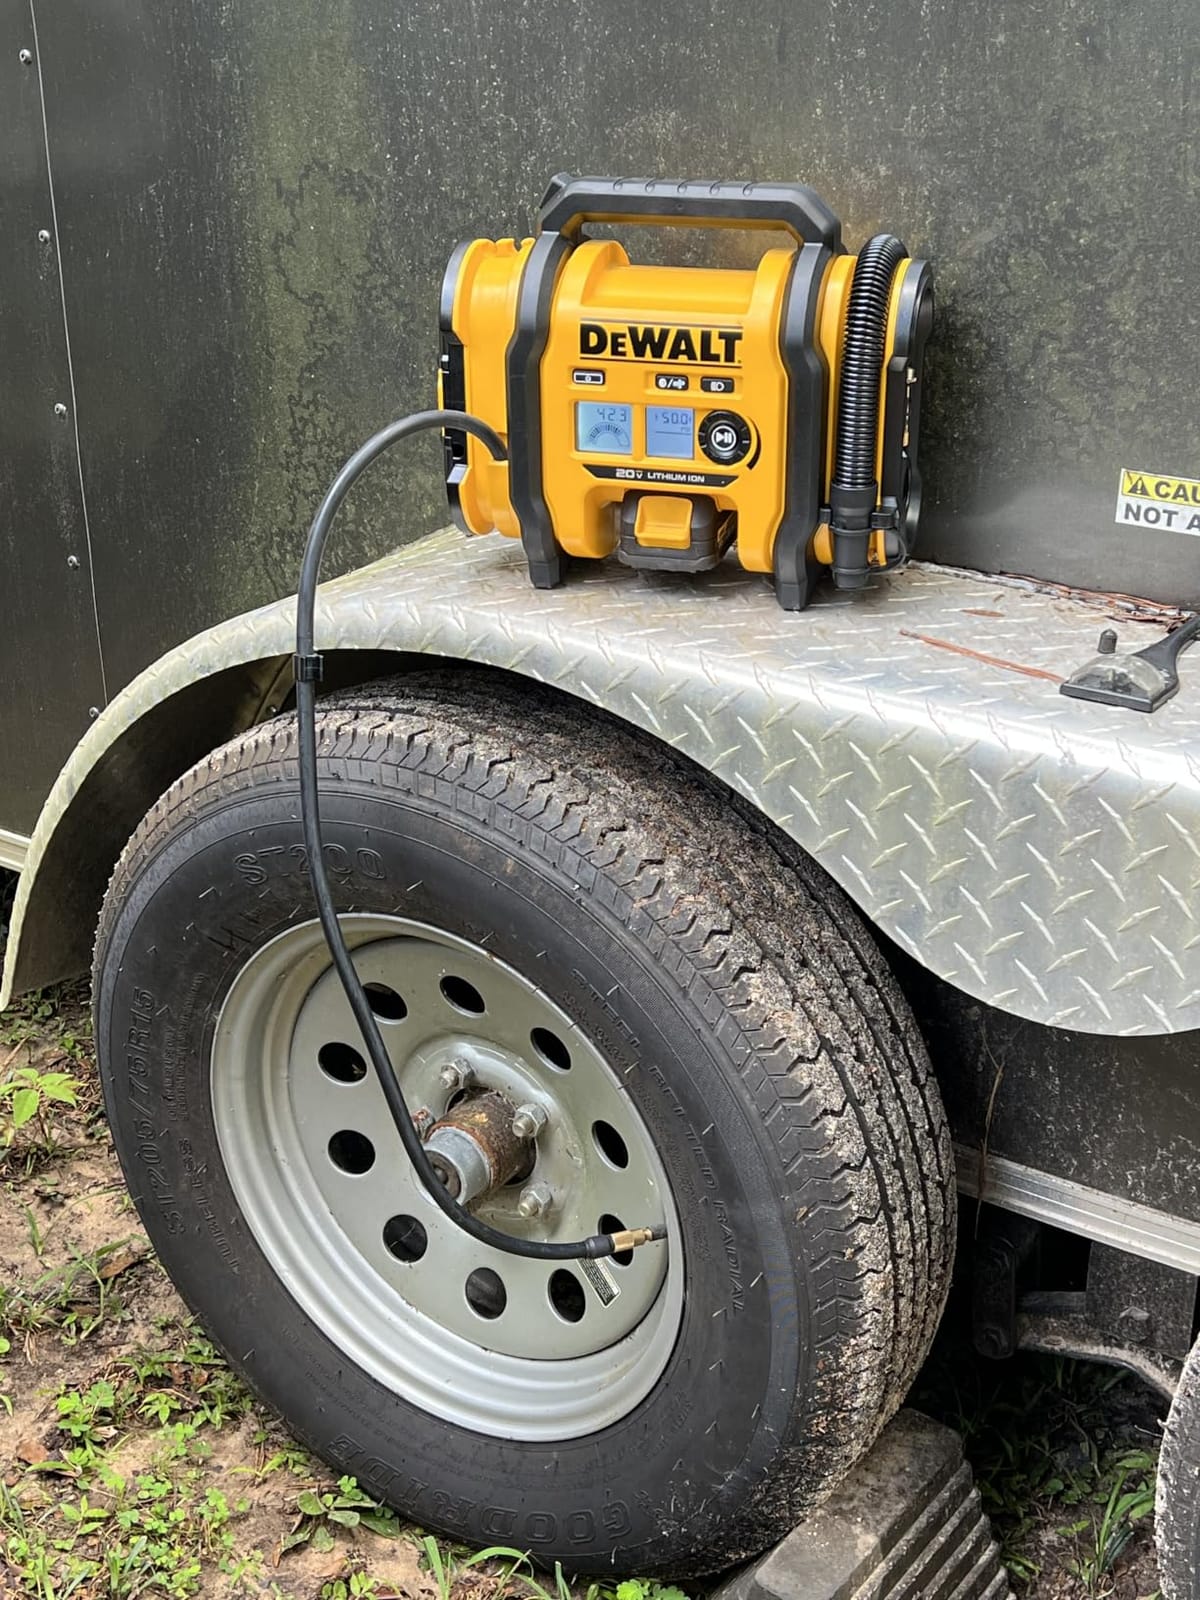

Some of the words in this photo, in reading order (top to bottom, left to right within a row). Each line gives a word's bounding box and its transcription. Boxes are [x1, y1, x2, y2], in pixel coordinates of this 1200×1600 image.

[647, 472, 687, 482] LITHIUM
[688, 474, 705, 483] ION
[1124, 503, 1179, 527] NOT
[327, 1433, 633, 1546] GOODRIDE
